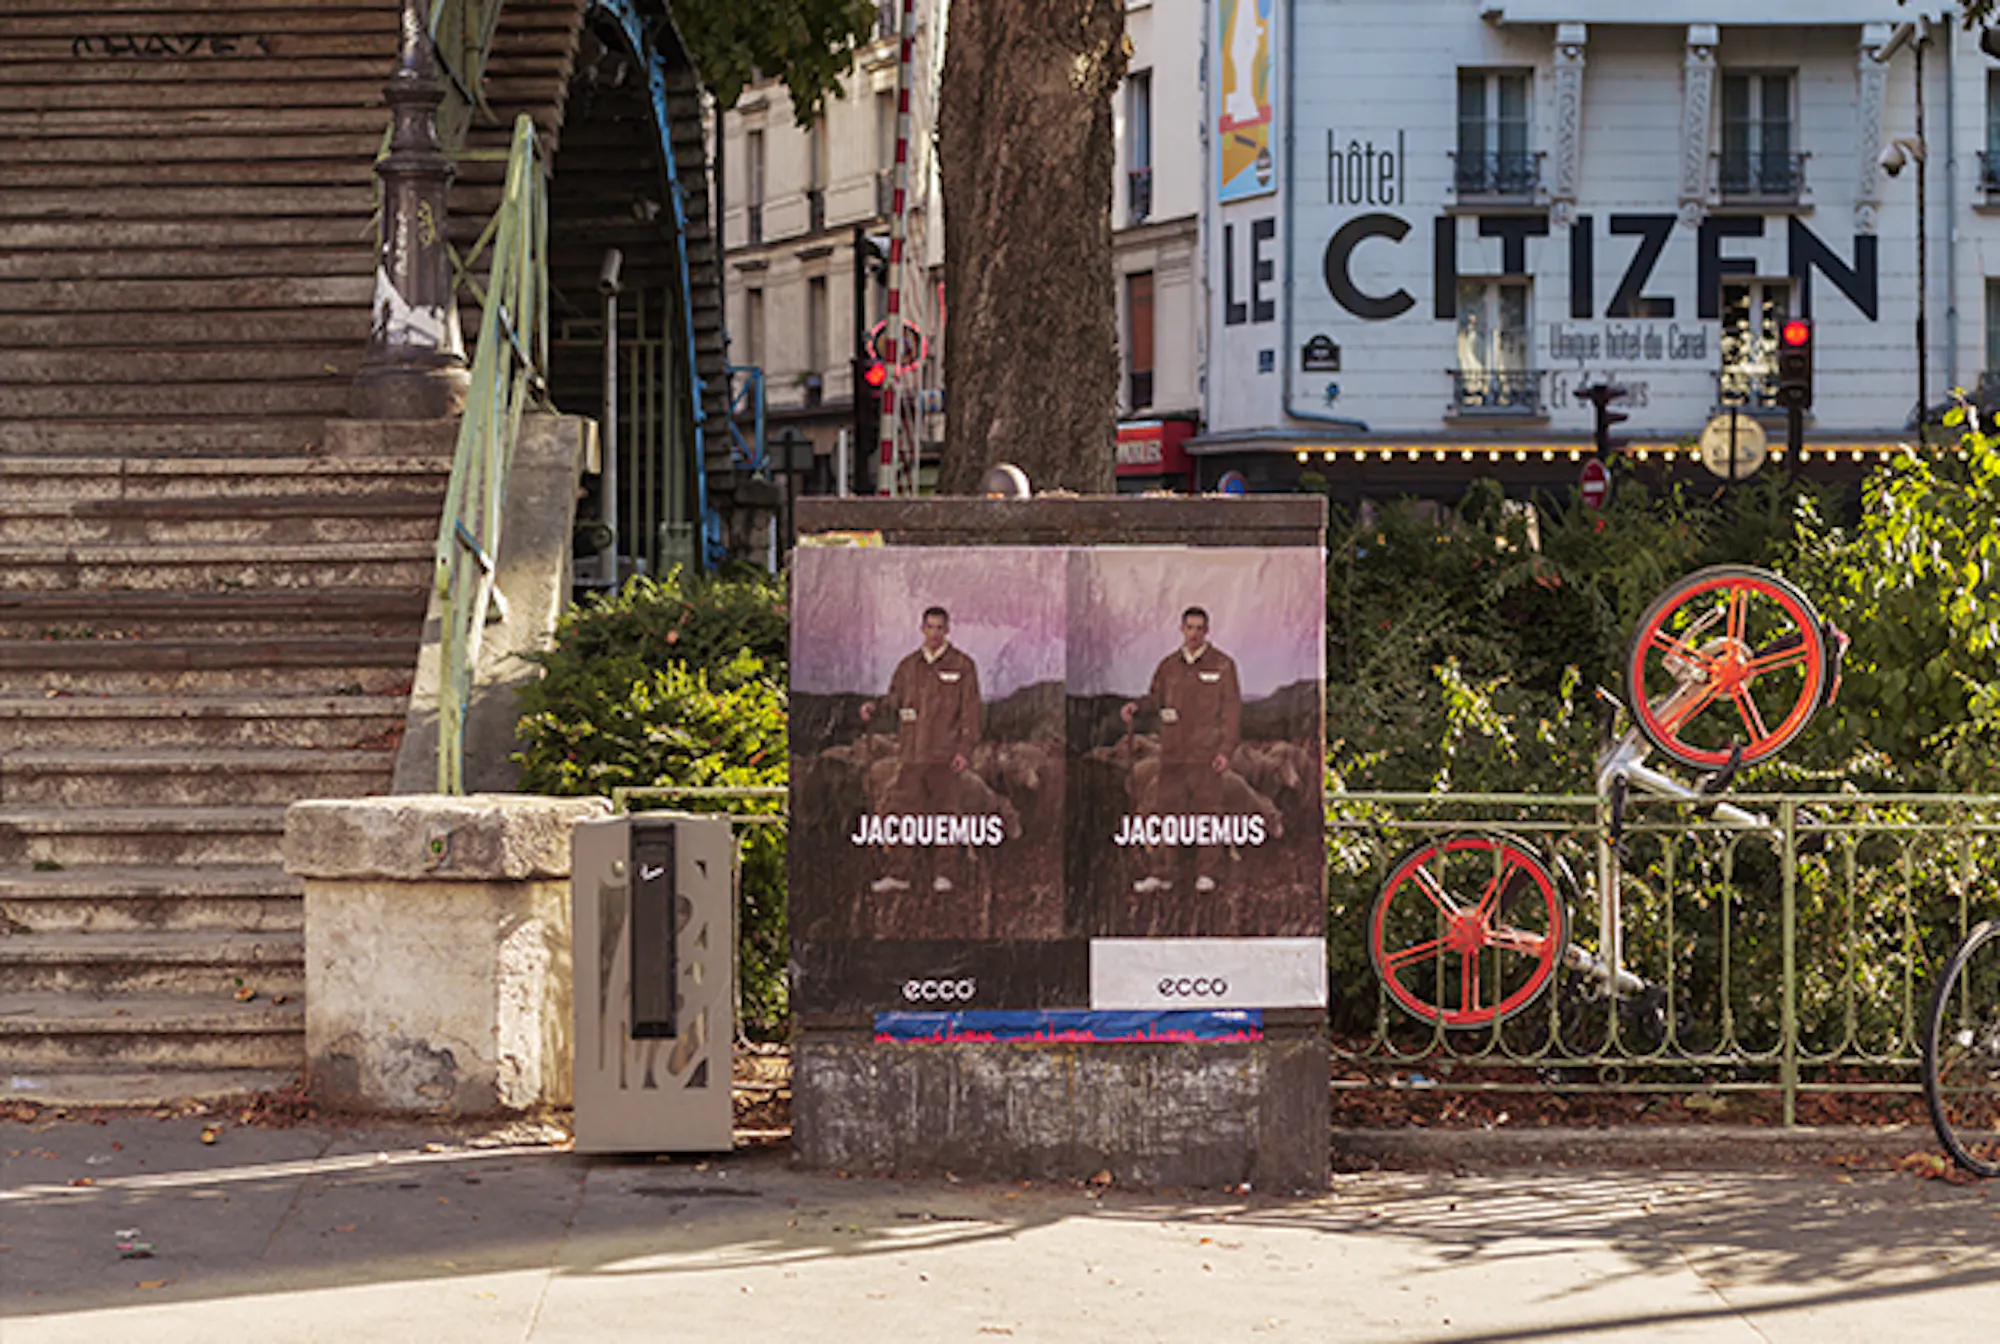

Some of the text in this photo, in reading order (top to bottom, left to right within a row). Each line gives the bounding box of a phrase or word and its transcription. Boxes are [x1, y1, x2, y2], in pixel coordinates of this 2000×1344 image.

[1327, 128, 1405, 206] hôtel
[1224, 217, 1276, 326] LE
[1323, 213, 1879, 323] CITIZEN
[1549, 323, 1599, 367] Unique
[1645, 323, 1662, 360] du
[851, 814, 1003, 846] JACQUEMUS
[1113, 814, 1267, 846] JACQUEMUS
[902, 979, 974, 1001] ecco
[1157, 978, 1227, 997] ecco
